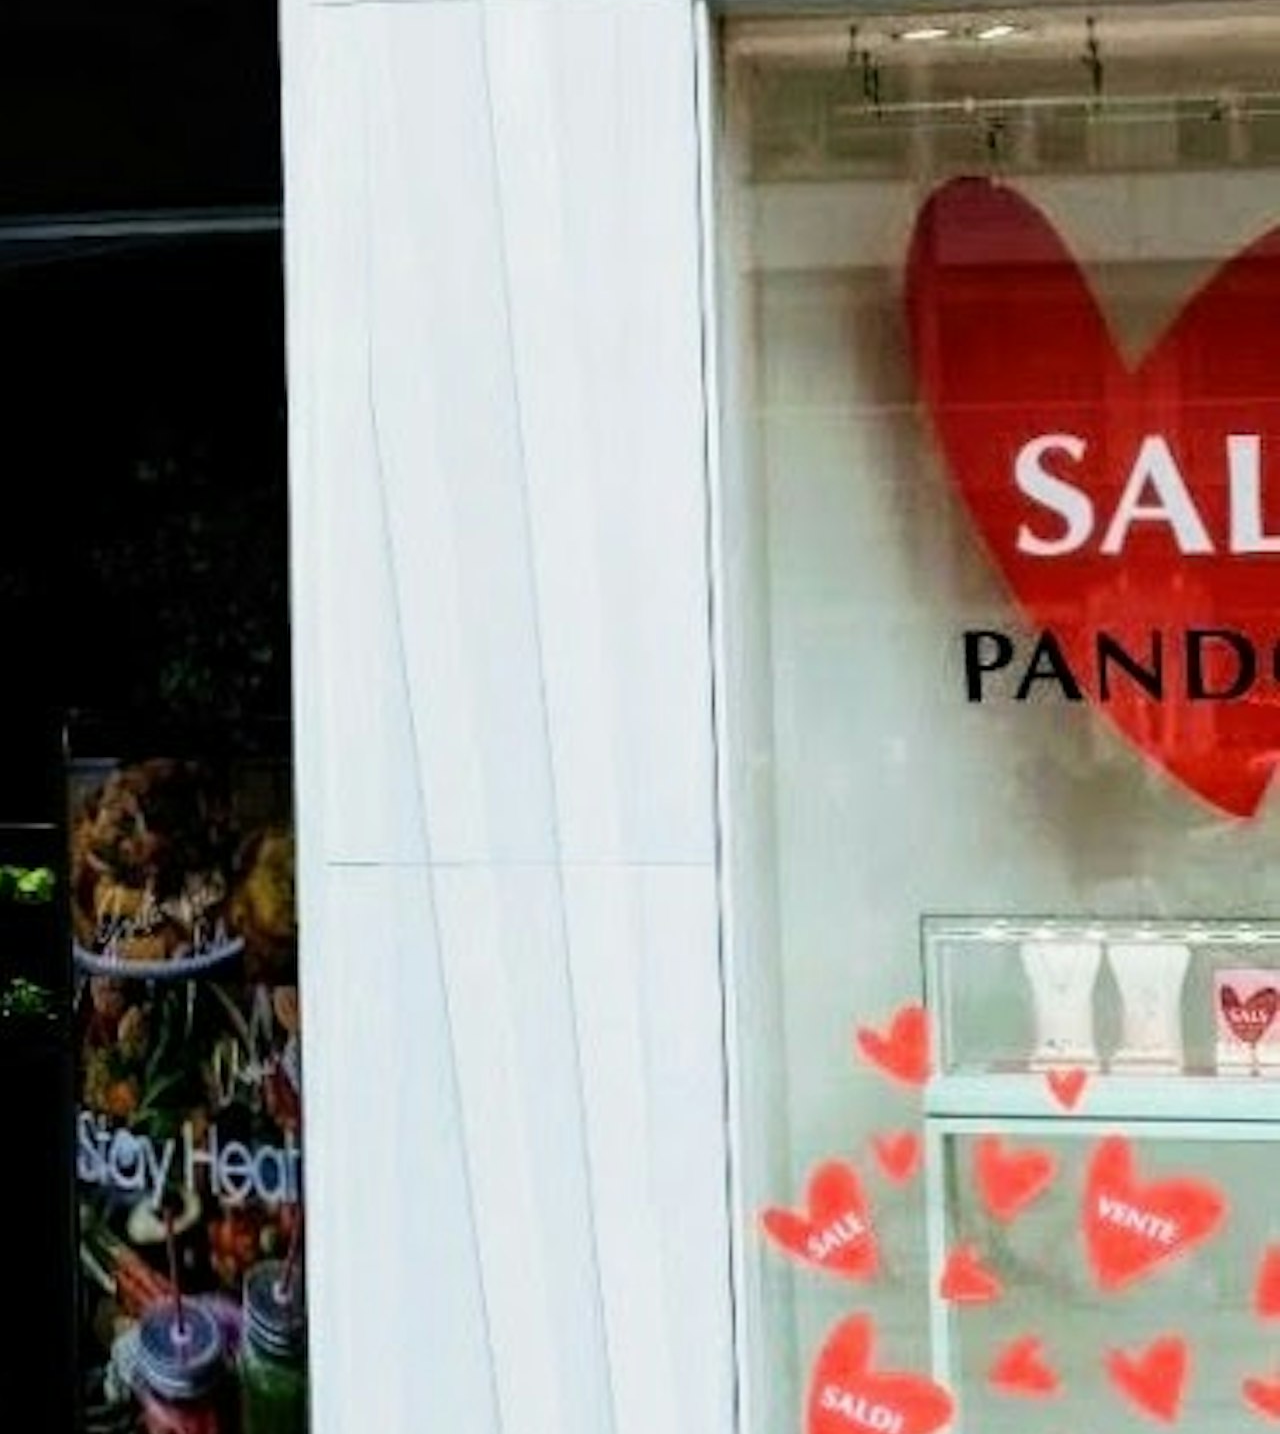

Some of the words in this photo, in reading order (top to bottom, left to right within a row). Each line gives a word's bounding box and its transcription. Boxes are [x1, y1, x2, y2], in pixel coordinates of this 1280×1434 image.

[962, 628, 1280, 703] PAND
[76, 1110, 176, 1210] Stay
[807, 1211, 866, 1260] SALE
[1098, 1194, 1178, 1246] VENTE
